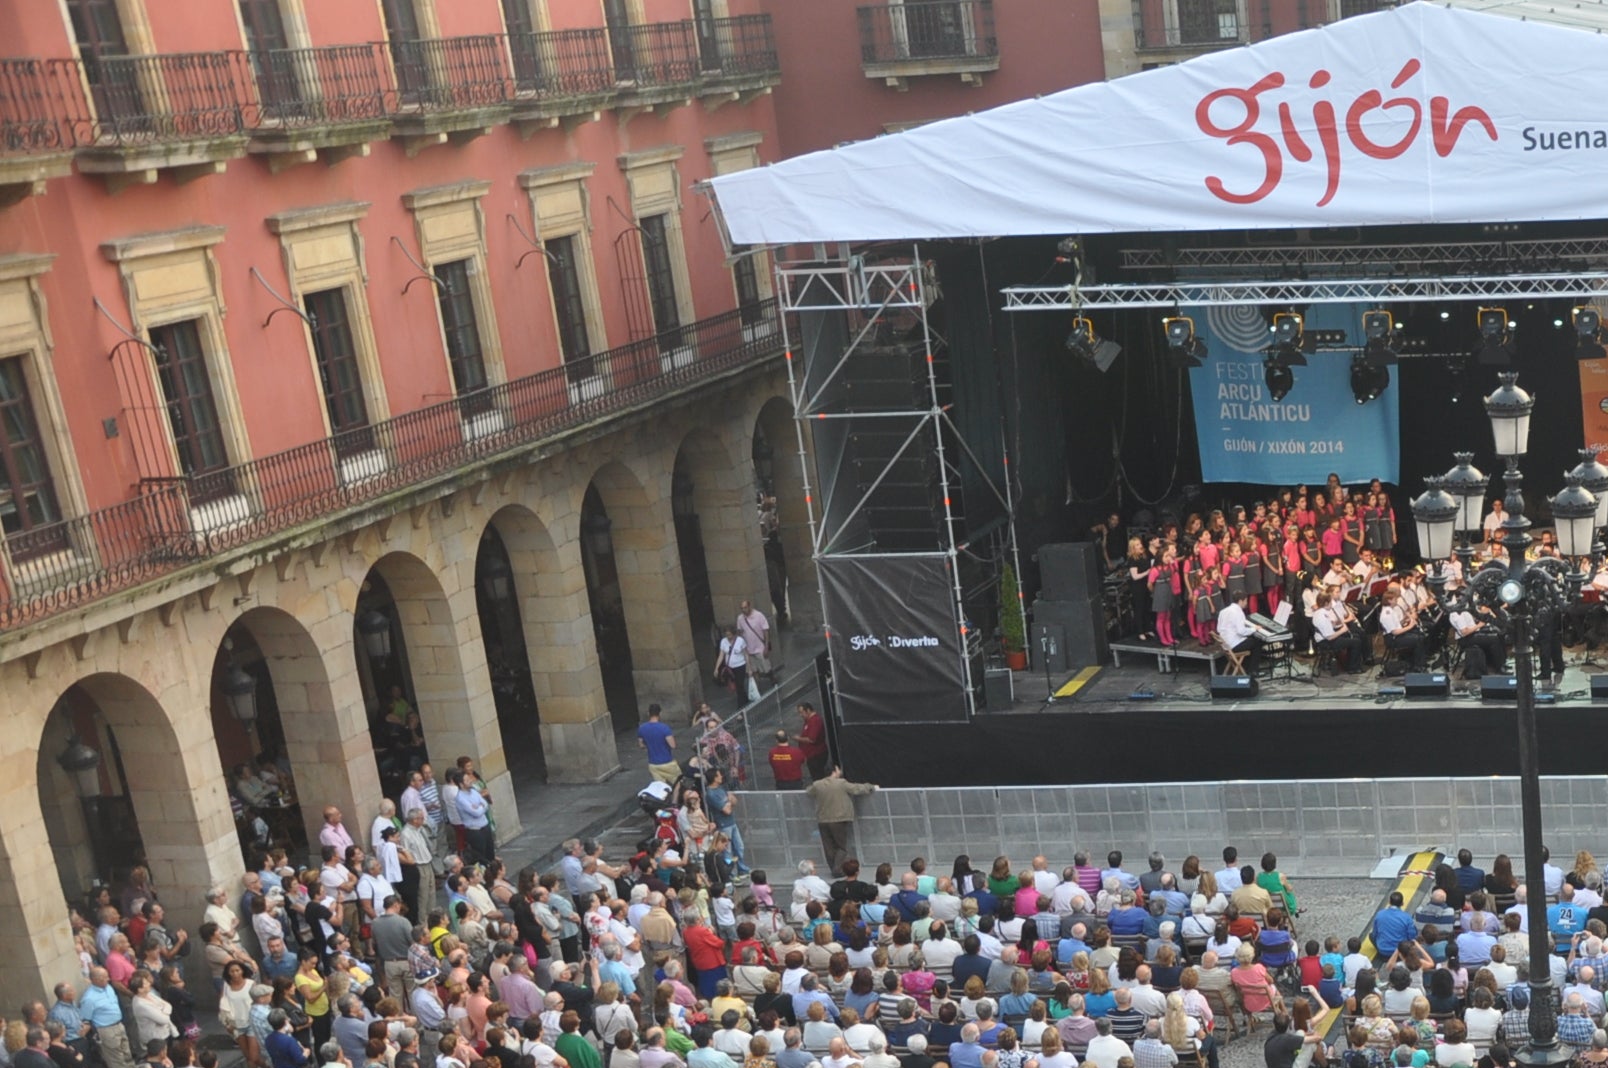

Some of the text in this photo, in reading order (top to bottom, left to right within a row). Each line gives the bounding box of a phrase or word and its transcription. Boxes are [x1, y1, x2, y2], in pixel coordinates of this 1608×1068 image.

[1195, 58, 1498, 207] gijón
[1522, 127, 1607, 151] Suena
[1218, 383, 1262, 401] ARCU
[1220, 400, 1311, 422] ATLÁNTICU
[1224, 437, 1257, 453] GIJÓN
[1268, 438, 1306, 453] XIXÓN
[1310, 440, 1344, 453] 2014
[1560, 908, 1573, 919] 24
